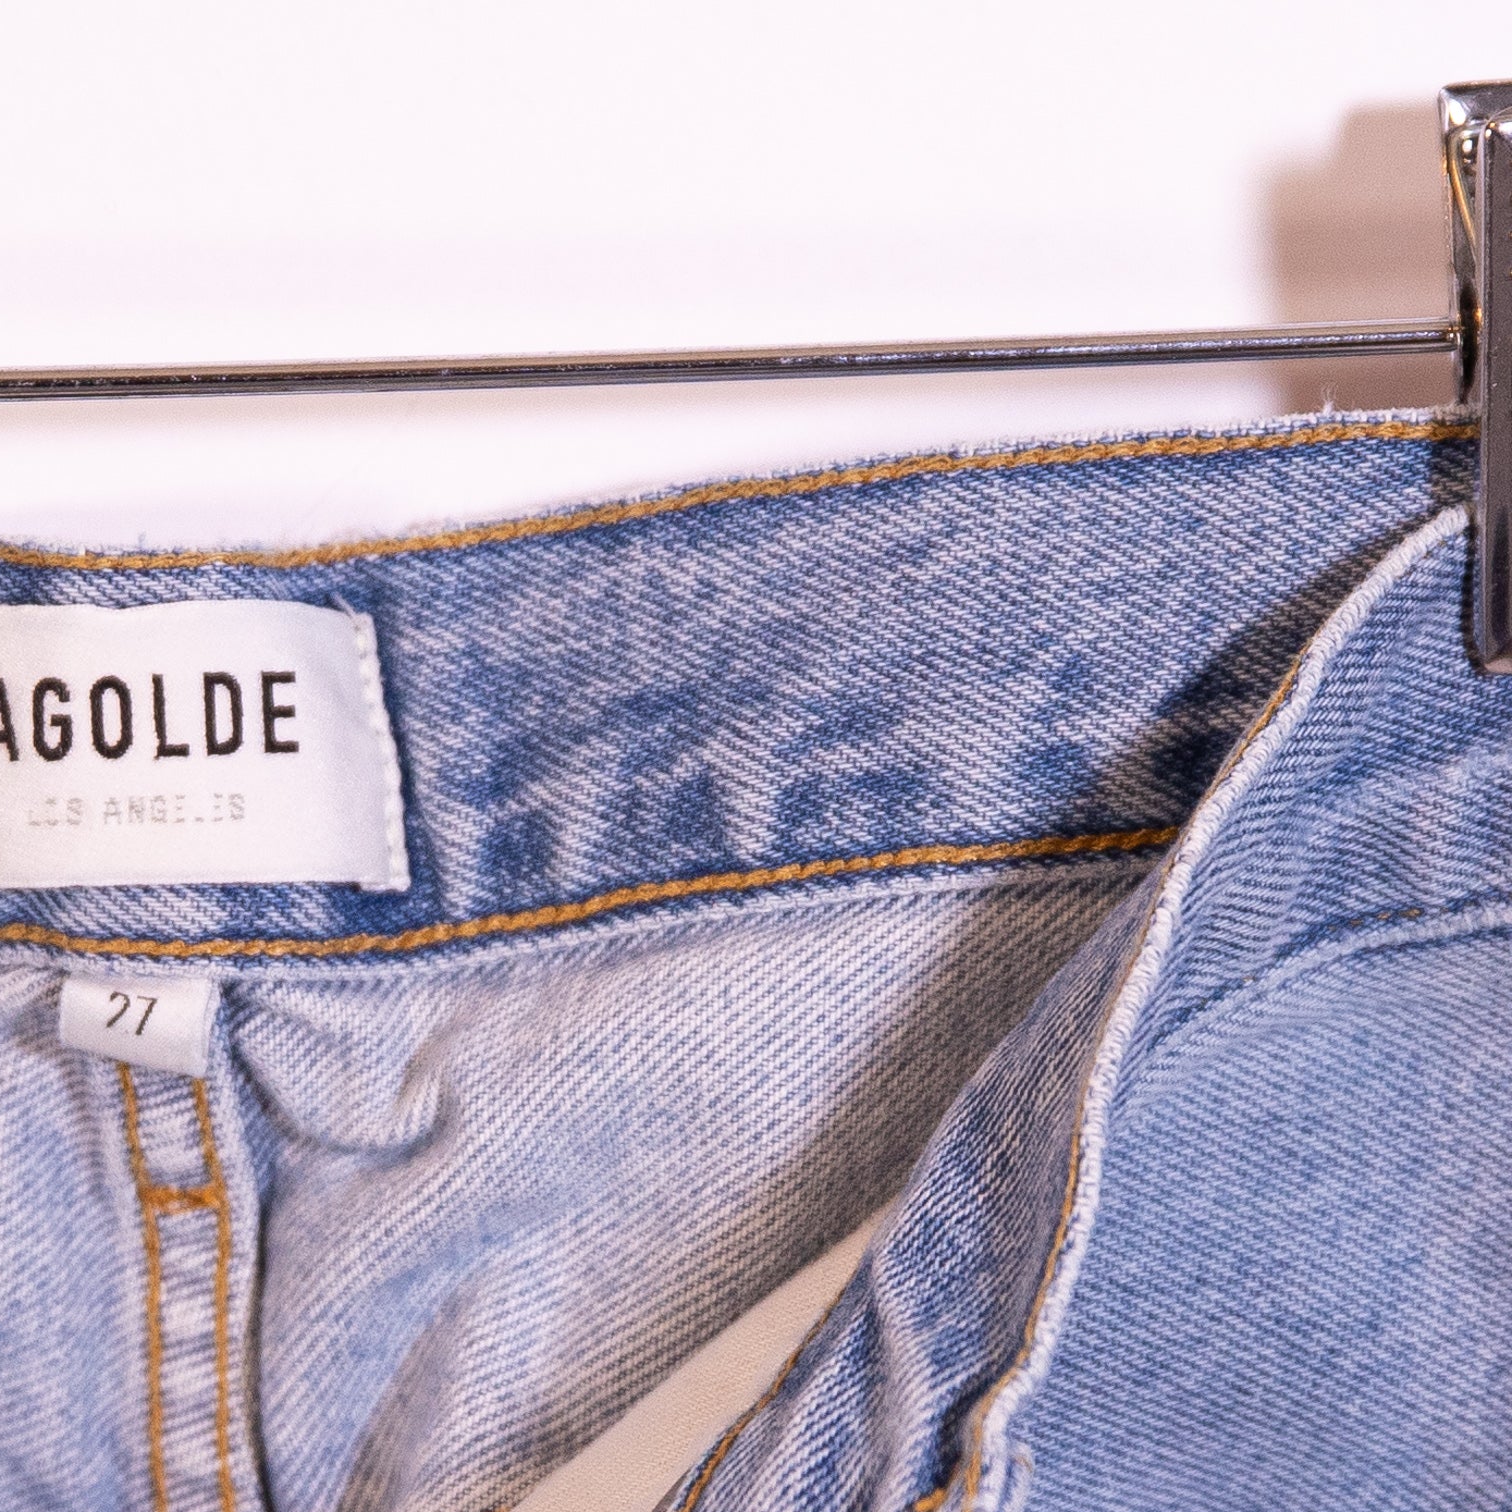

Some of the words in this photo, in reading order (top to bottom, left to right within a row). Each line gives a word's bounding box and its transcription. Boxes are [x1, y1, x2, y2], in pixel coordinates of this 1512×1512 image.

[28, 796, 83, 827] LOS
[104, 793, 246, 826] ANGELES
[106, 990, 158, 1036] 27
